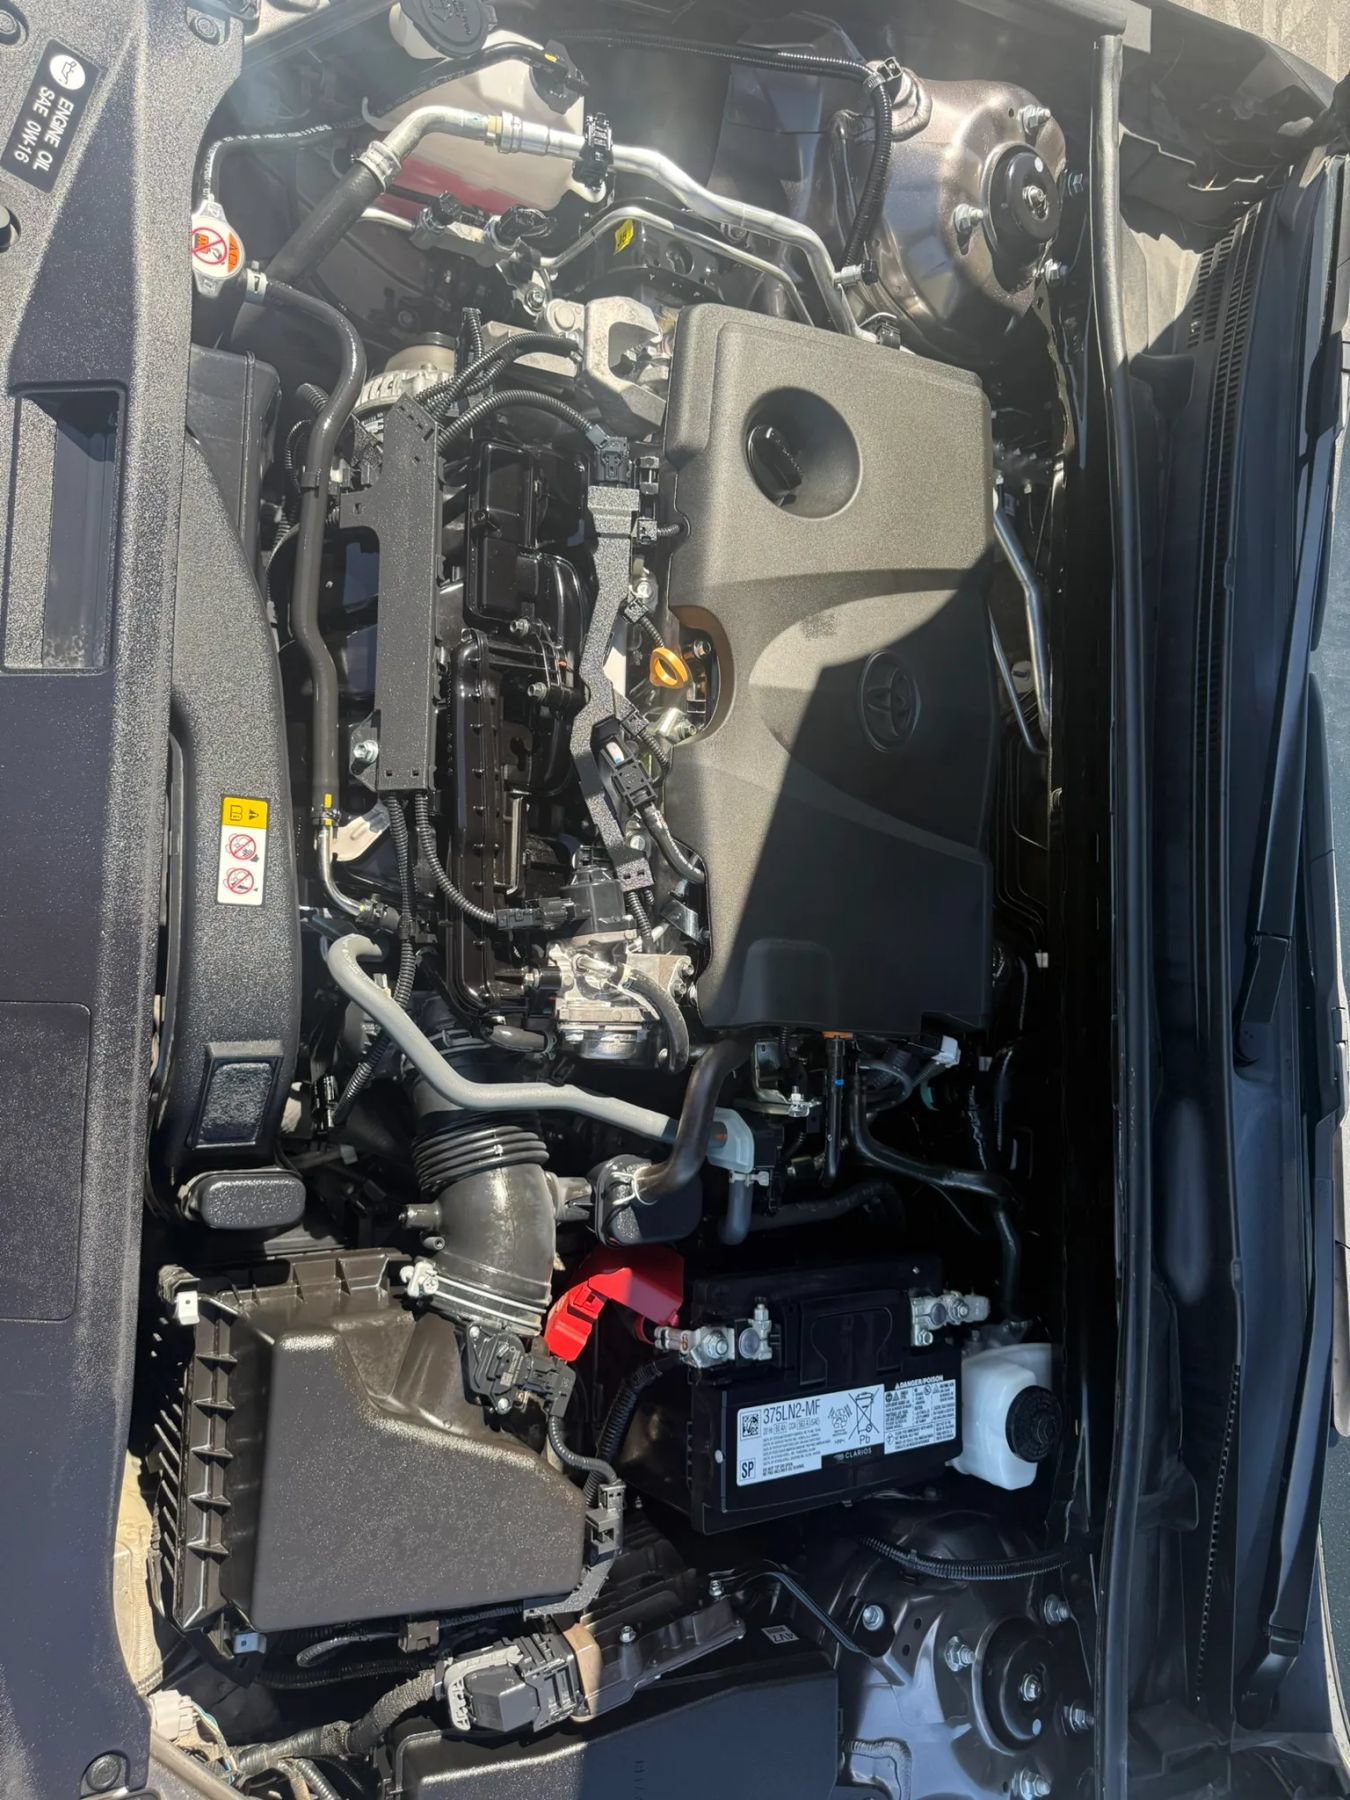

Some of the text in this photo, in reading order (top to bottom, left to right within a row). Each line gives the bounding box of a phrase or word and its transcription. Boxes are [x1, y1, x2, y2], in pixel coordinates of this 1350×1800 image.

[14, 86, 55, 163] SAE 0W-16
[33, 97, 74, 171] ENGINE OIL
[763, 1399, 821, 1424] 375LN2-MF
[859, 1434, 871, 1445] Pb
[845, 1447, 872, 1459] CLARIOS
[741, 1461, 754, 1479] SP
